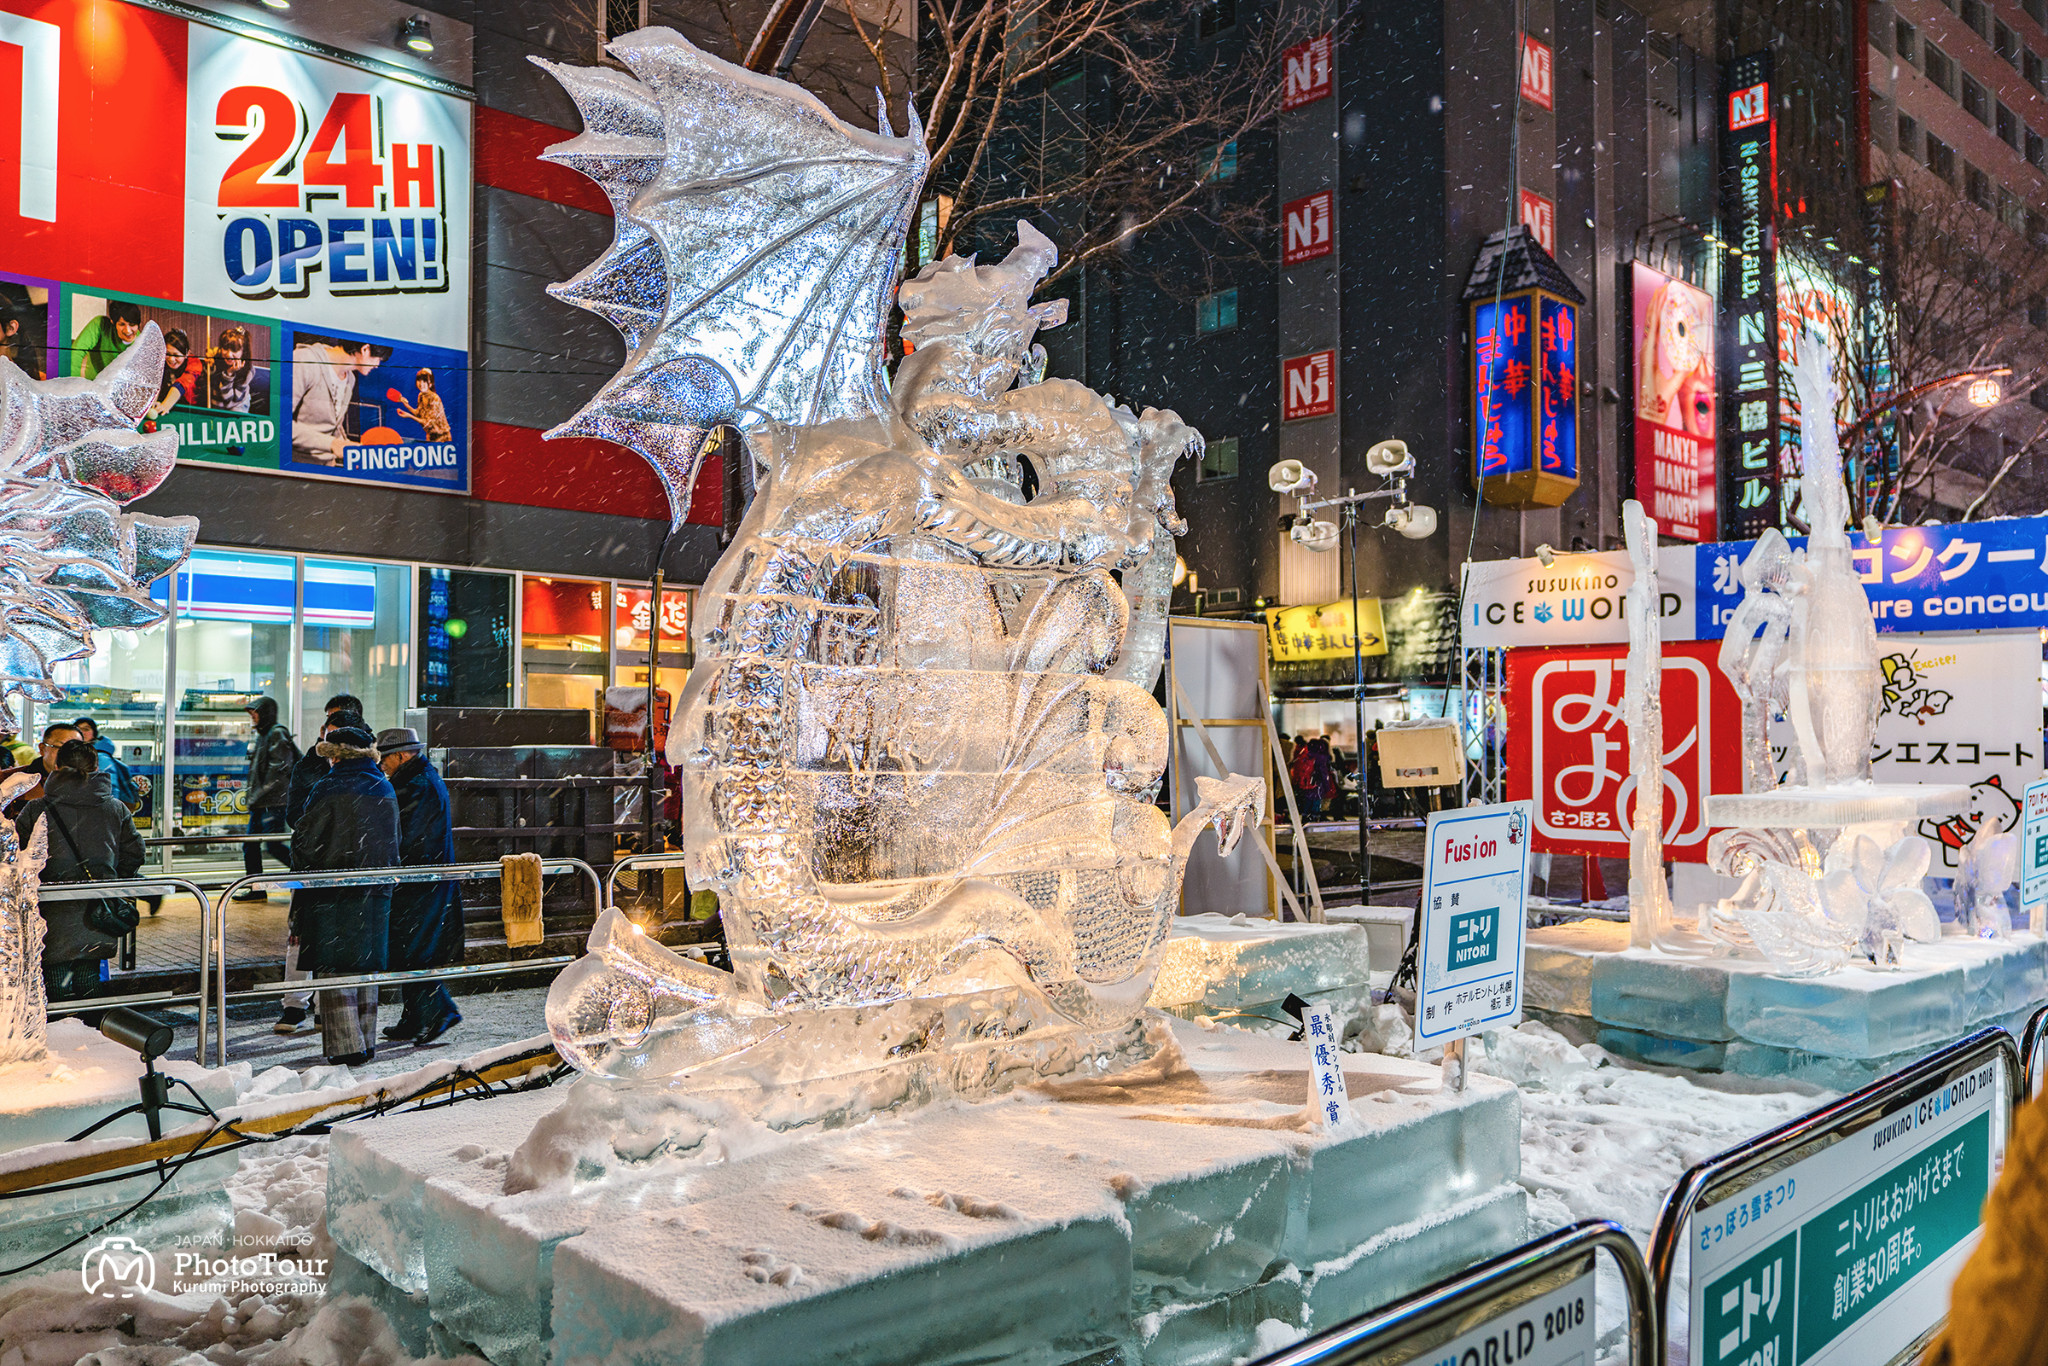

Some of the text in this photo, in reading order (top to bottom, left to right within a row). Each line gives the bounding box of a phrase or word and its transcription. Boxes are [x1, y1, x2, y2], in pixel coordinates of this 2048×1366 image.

[215, 85, 440, 210] 24H
[222, 215, 445, 292] OPEN!
[1503, 305, 1530, 400] 中華
[1558, 306, 1575, 406] 中華
[1476, 327, 1507, 471] まんじゅう
[1541, 316, 1561, 469] まんじゅう
[346, 445, 457, 470] PINGPONG
[1654, 429, 1698, 467] MANY!!
[1654, 460, 1698, 496] MANY!!
[1655, 490, 1698, 525] MONEY!
[1473, 592, 1682, 626] ICE WOD
[1527, 574, 1619, 594] SUSUKINO
[1445, 834, 1497, 864] Fusion
[1551, 810, 1610, 828] さっぽろ
[1455, 944, 1489, 963] NITORI
[1457, 914, 1492, 944] ニトリ
[1310, 1014, 1340, 1126] 最優秀賞
[1873, 1067, 1994, 1151] SUSUKINO ICE WORLD 2018
[1700, 1177, 1796, 1251] さっぽろ雪まつり
[1835, 1141, 1965, 1258] ニトリはおかげさまで
[1719, 1257, 1783, 1360] ニトリ
[1832, 1225, 1922, 1322] 創業50周年。
[1544, 1297, 1585, 1341] 2018
